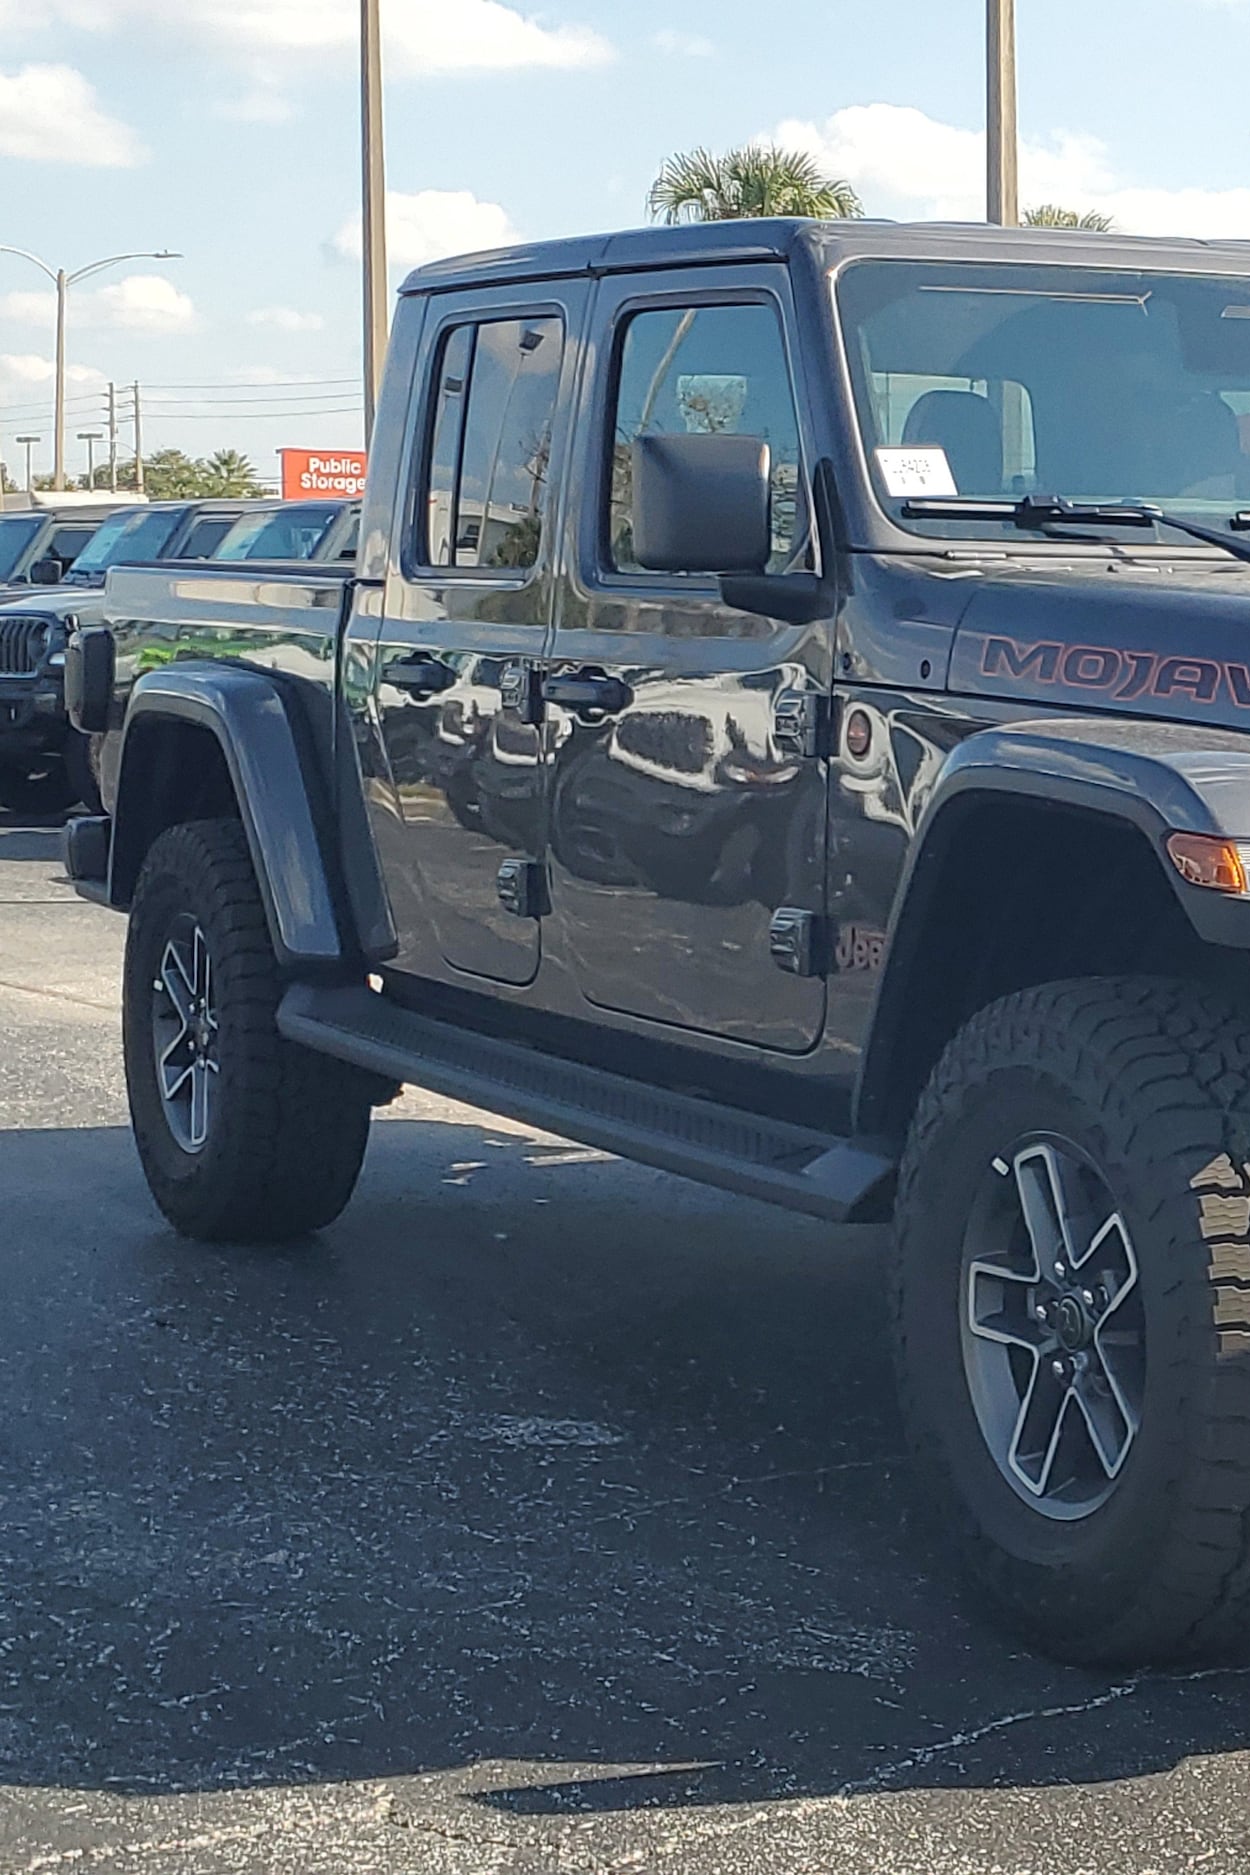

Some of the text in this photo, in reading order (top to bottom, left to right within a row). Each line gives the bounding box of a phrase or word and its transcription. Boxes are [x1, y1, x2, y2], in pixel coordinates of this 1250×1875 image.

[308, 457, 362, 474] Public
[300, 472, 367, 494] Storage
[835, 926, 888, 971] Jee
